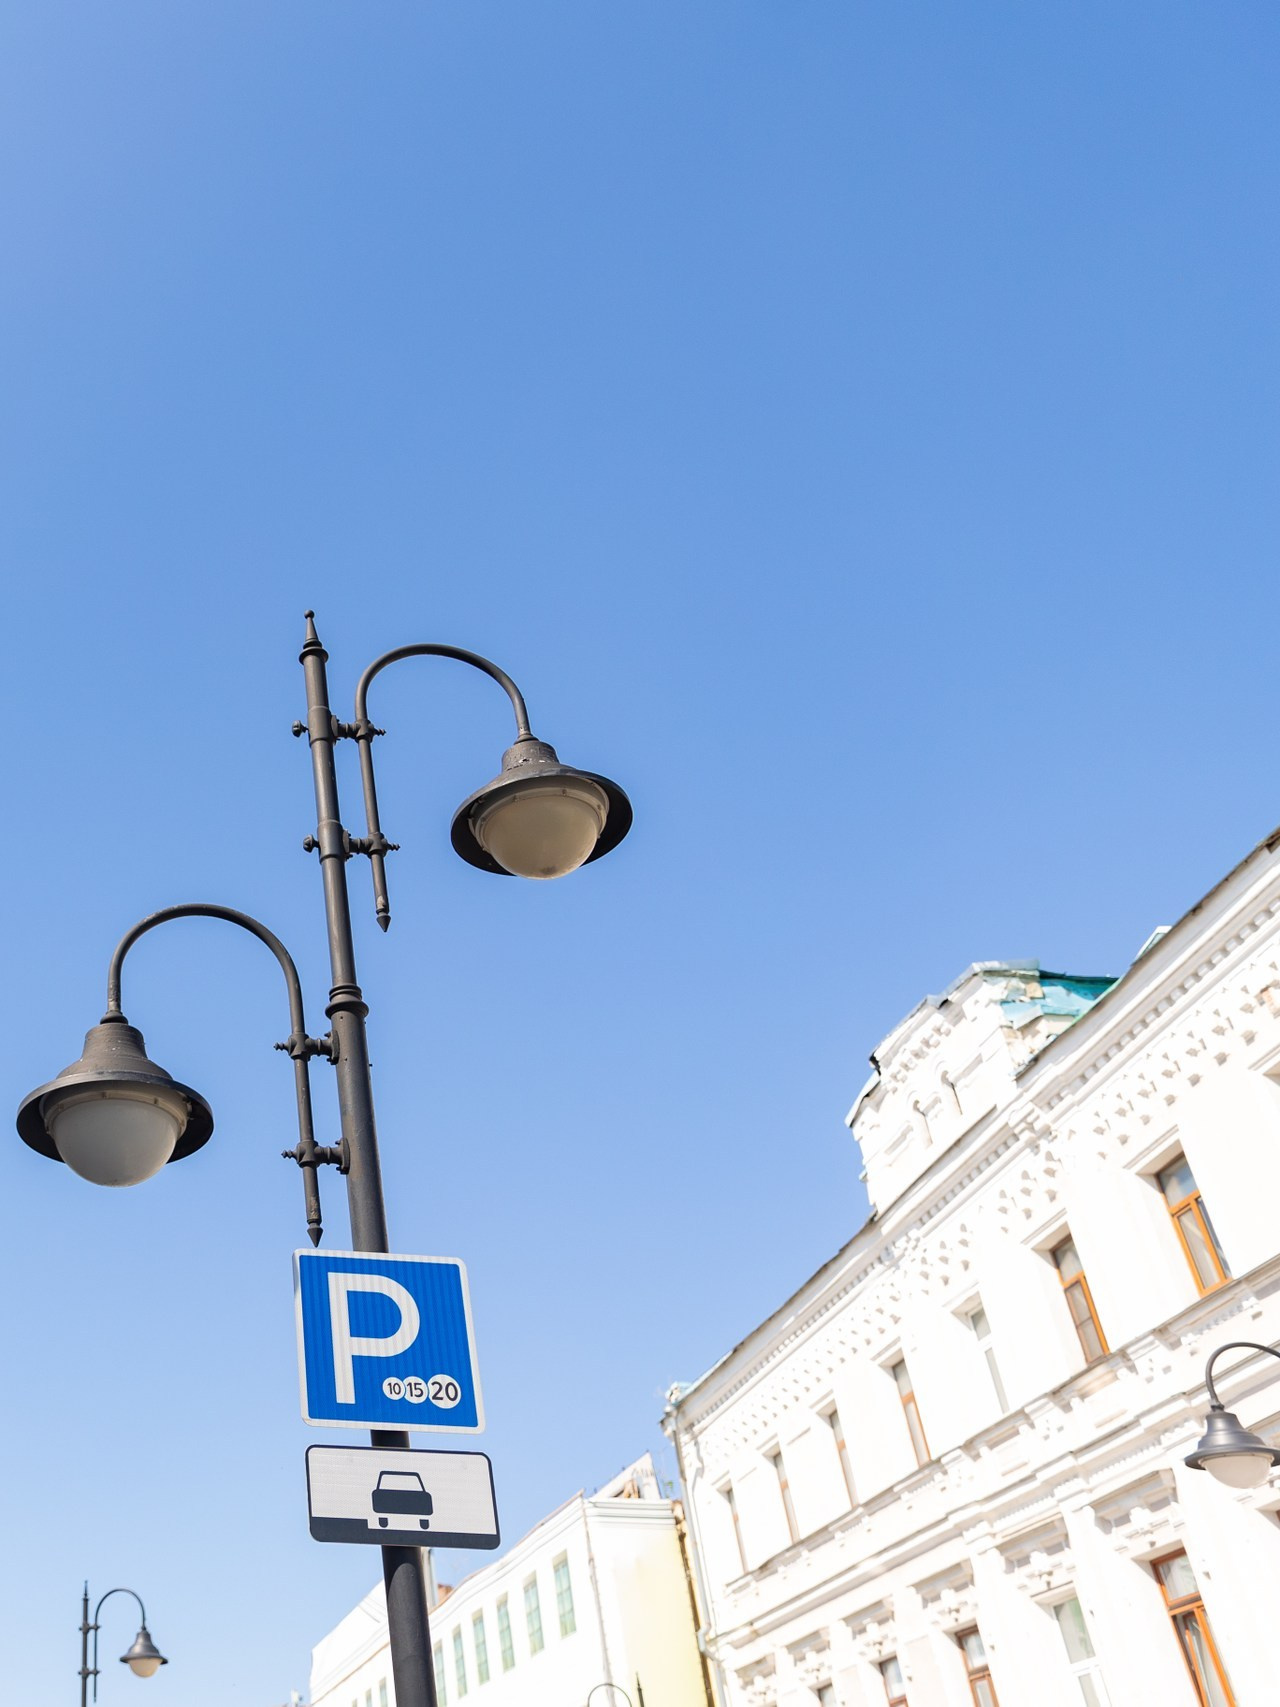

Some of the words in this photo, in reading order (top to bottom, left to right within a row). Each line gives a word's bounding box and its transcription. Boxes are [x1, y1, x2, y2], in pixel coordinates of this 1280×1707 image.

[327, 1271, 421, 1405] P
[386, 1382, 402, 1396] 10
[406, 1381, 424, 1398] 15
[431, 1380, 459, 1402] 20
